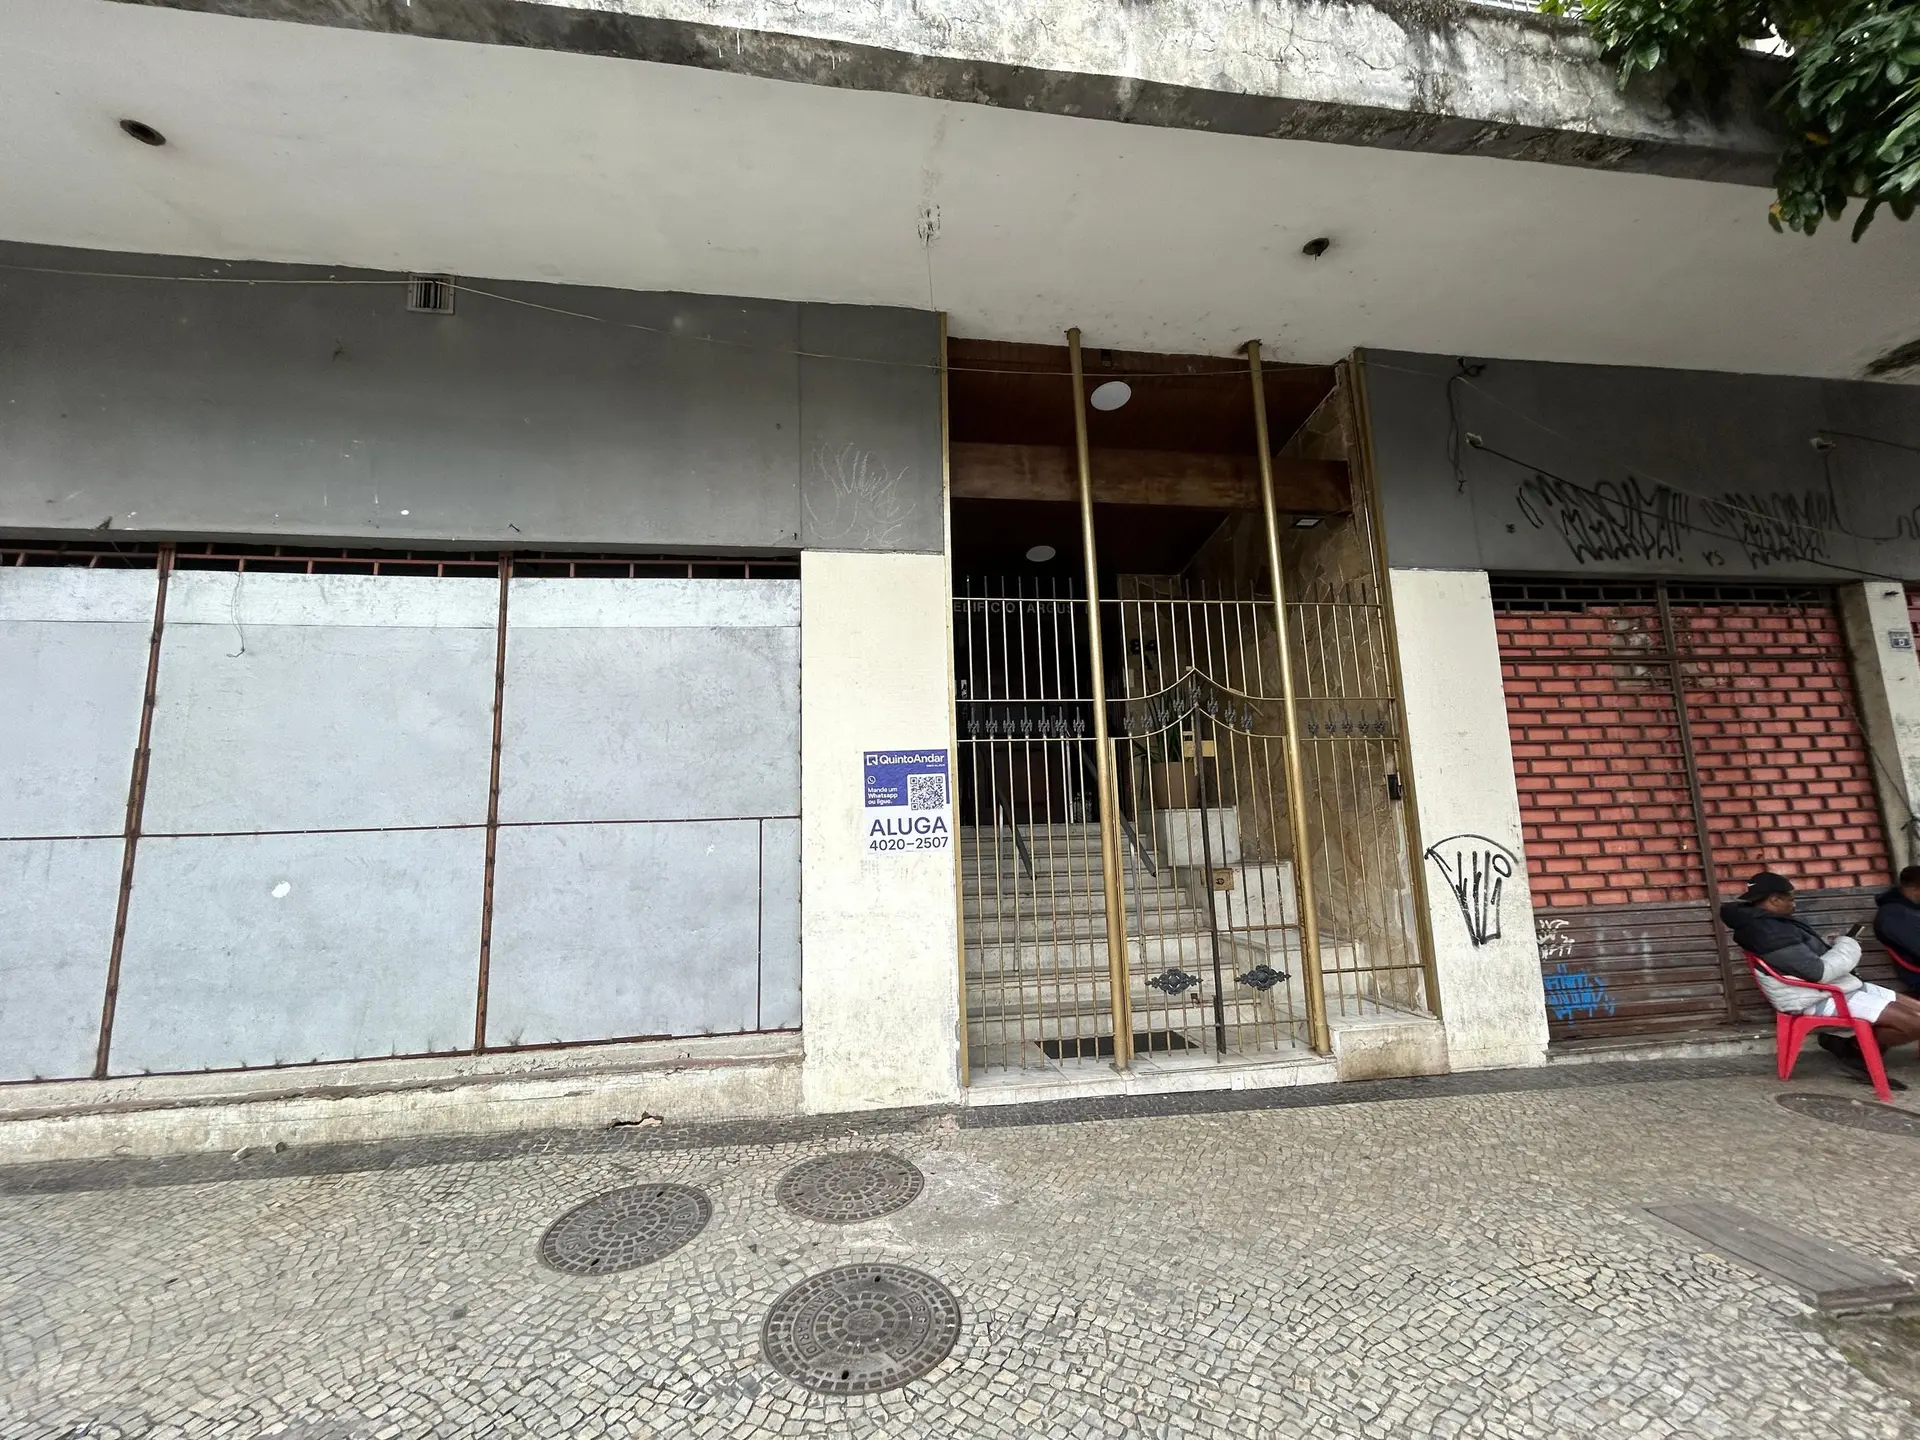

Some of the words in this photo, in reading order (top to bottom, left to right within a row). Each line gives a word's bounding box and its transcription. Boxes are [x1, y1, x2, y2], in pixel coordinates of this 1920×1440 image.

[880, 753, 945, 764] QuintoAndar
[869, 816, 948, 836] ALUGA
[869, 836, 949, 851] 4020-2507
[895, 1295, 927, 1356] ESGOTO
